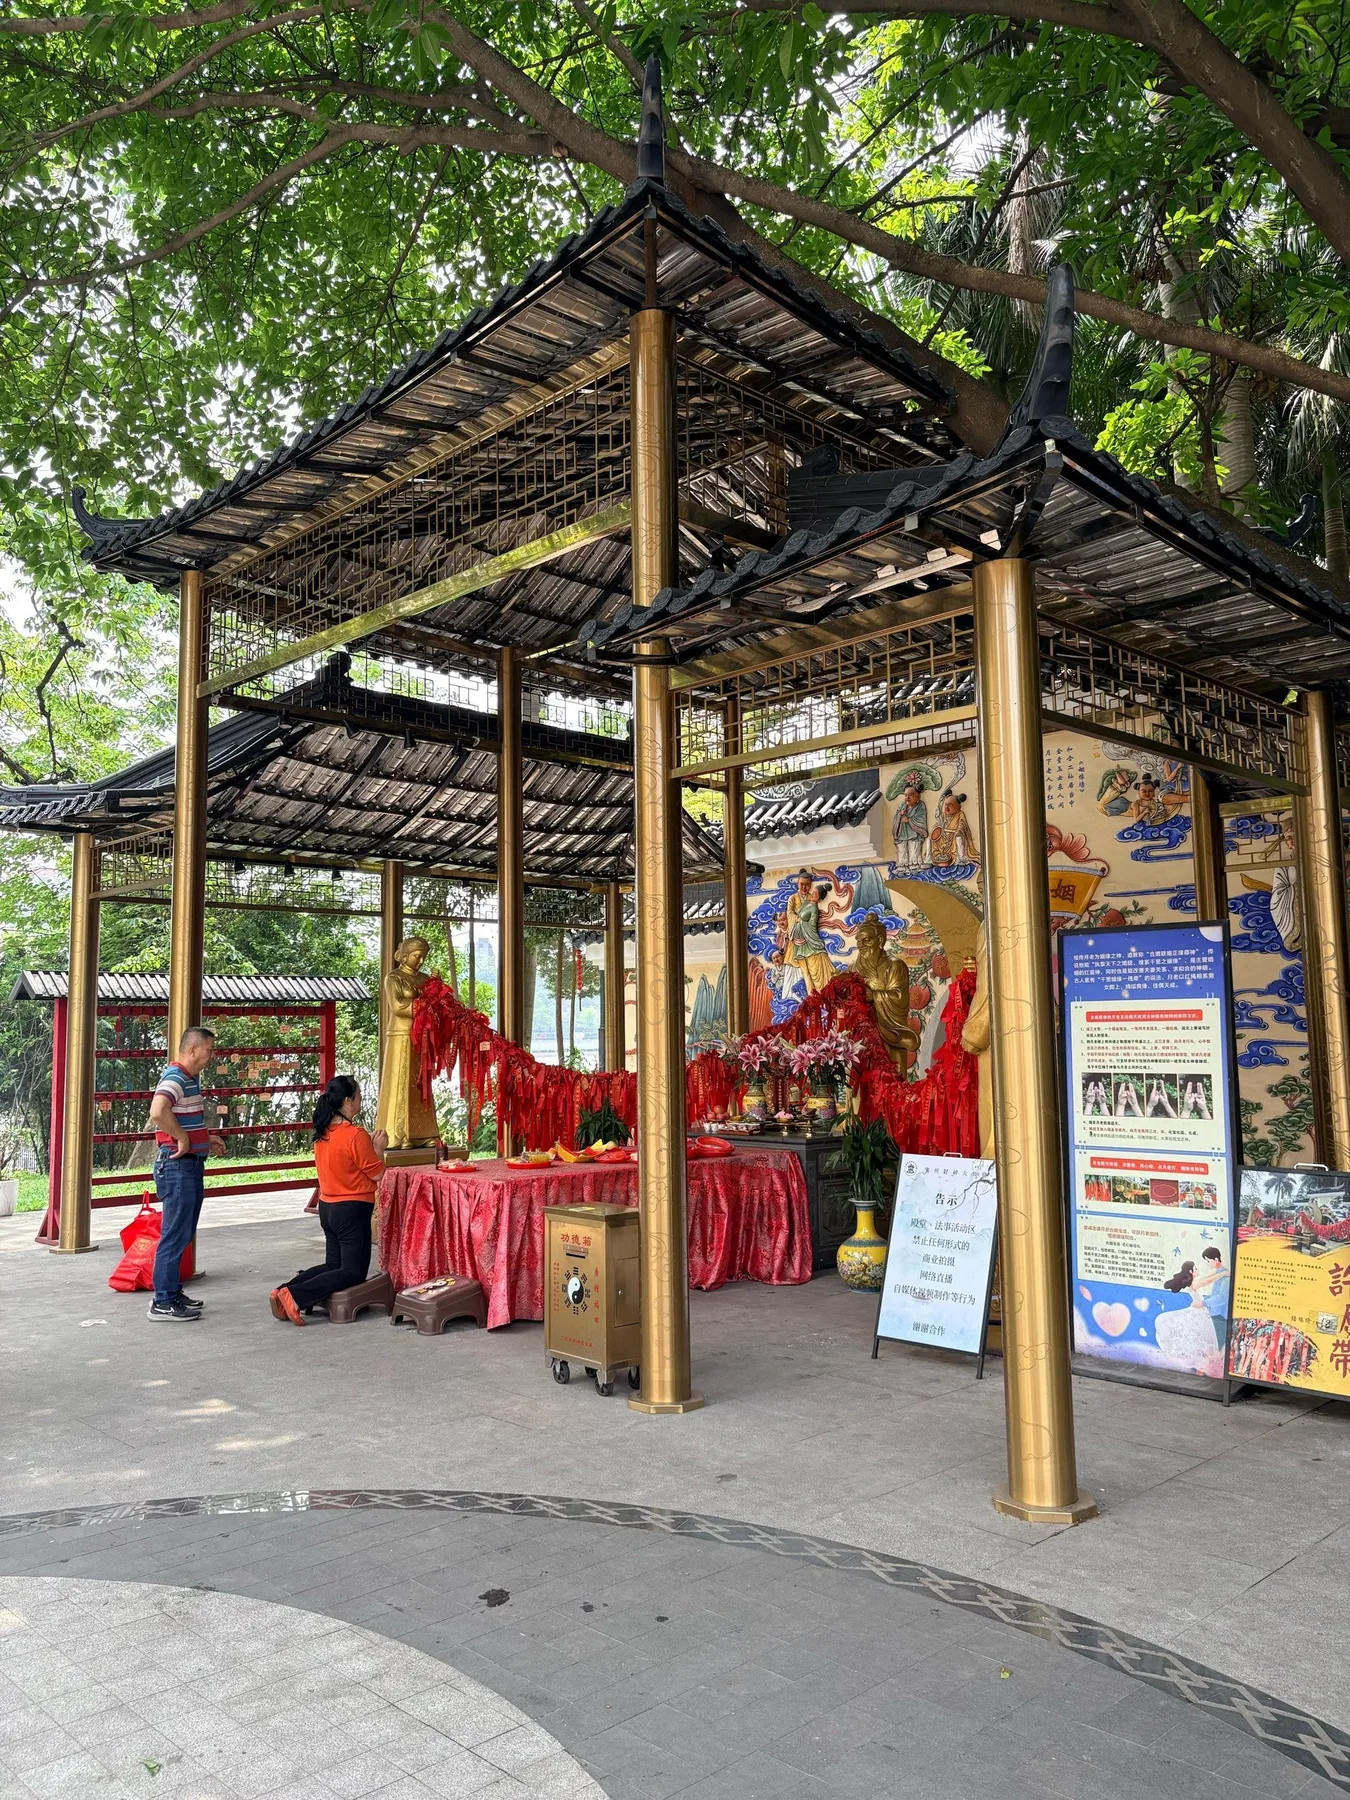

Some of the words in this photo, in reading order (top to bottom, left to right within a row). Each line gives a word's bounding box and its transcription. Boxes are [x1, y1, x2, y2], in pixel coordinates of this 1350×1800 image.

[1050, 878, 1076, 904] 姻
[935, 1193, 958, 1206] 告示
[911, 1217, 976, 1235] 殿堂、法事活动区
[560, 1232, 592, 1247] 功德箱
[912, 1235, 970, 1251] 禁止任何形式的
[922, 1253, 956, 1267] 商业拍摄
[919, 1270, 953, 1285] 网络直播
[893, 1284, 976, 1306] 自媒体视频制作等行为
[912, 1321, 947, 1336] 谢谢合作
